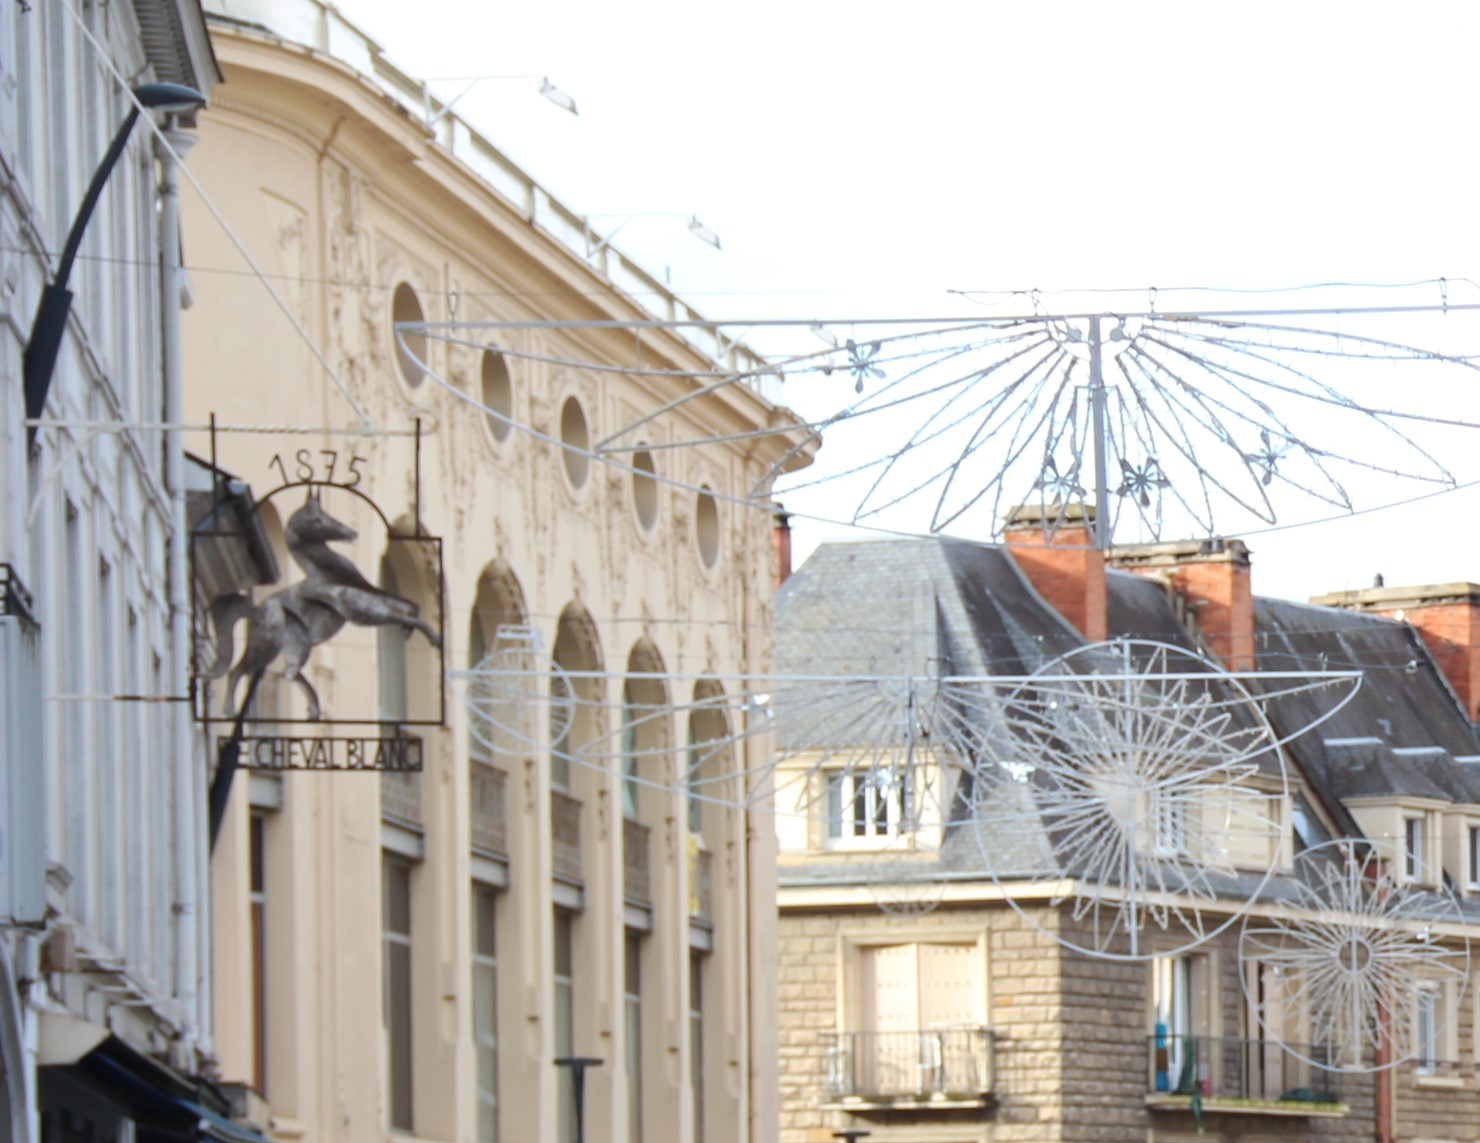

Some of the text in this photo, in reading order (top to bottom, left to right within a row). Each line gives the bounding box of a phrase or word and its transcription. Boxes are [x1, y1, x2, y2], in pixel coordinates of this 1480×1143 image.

[268, 450, 367, 487] 1875
[256, 738, 340, 769] CHEVAL
[347, 738, 420, 771] BLANC
